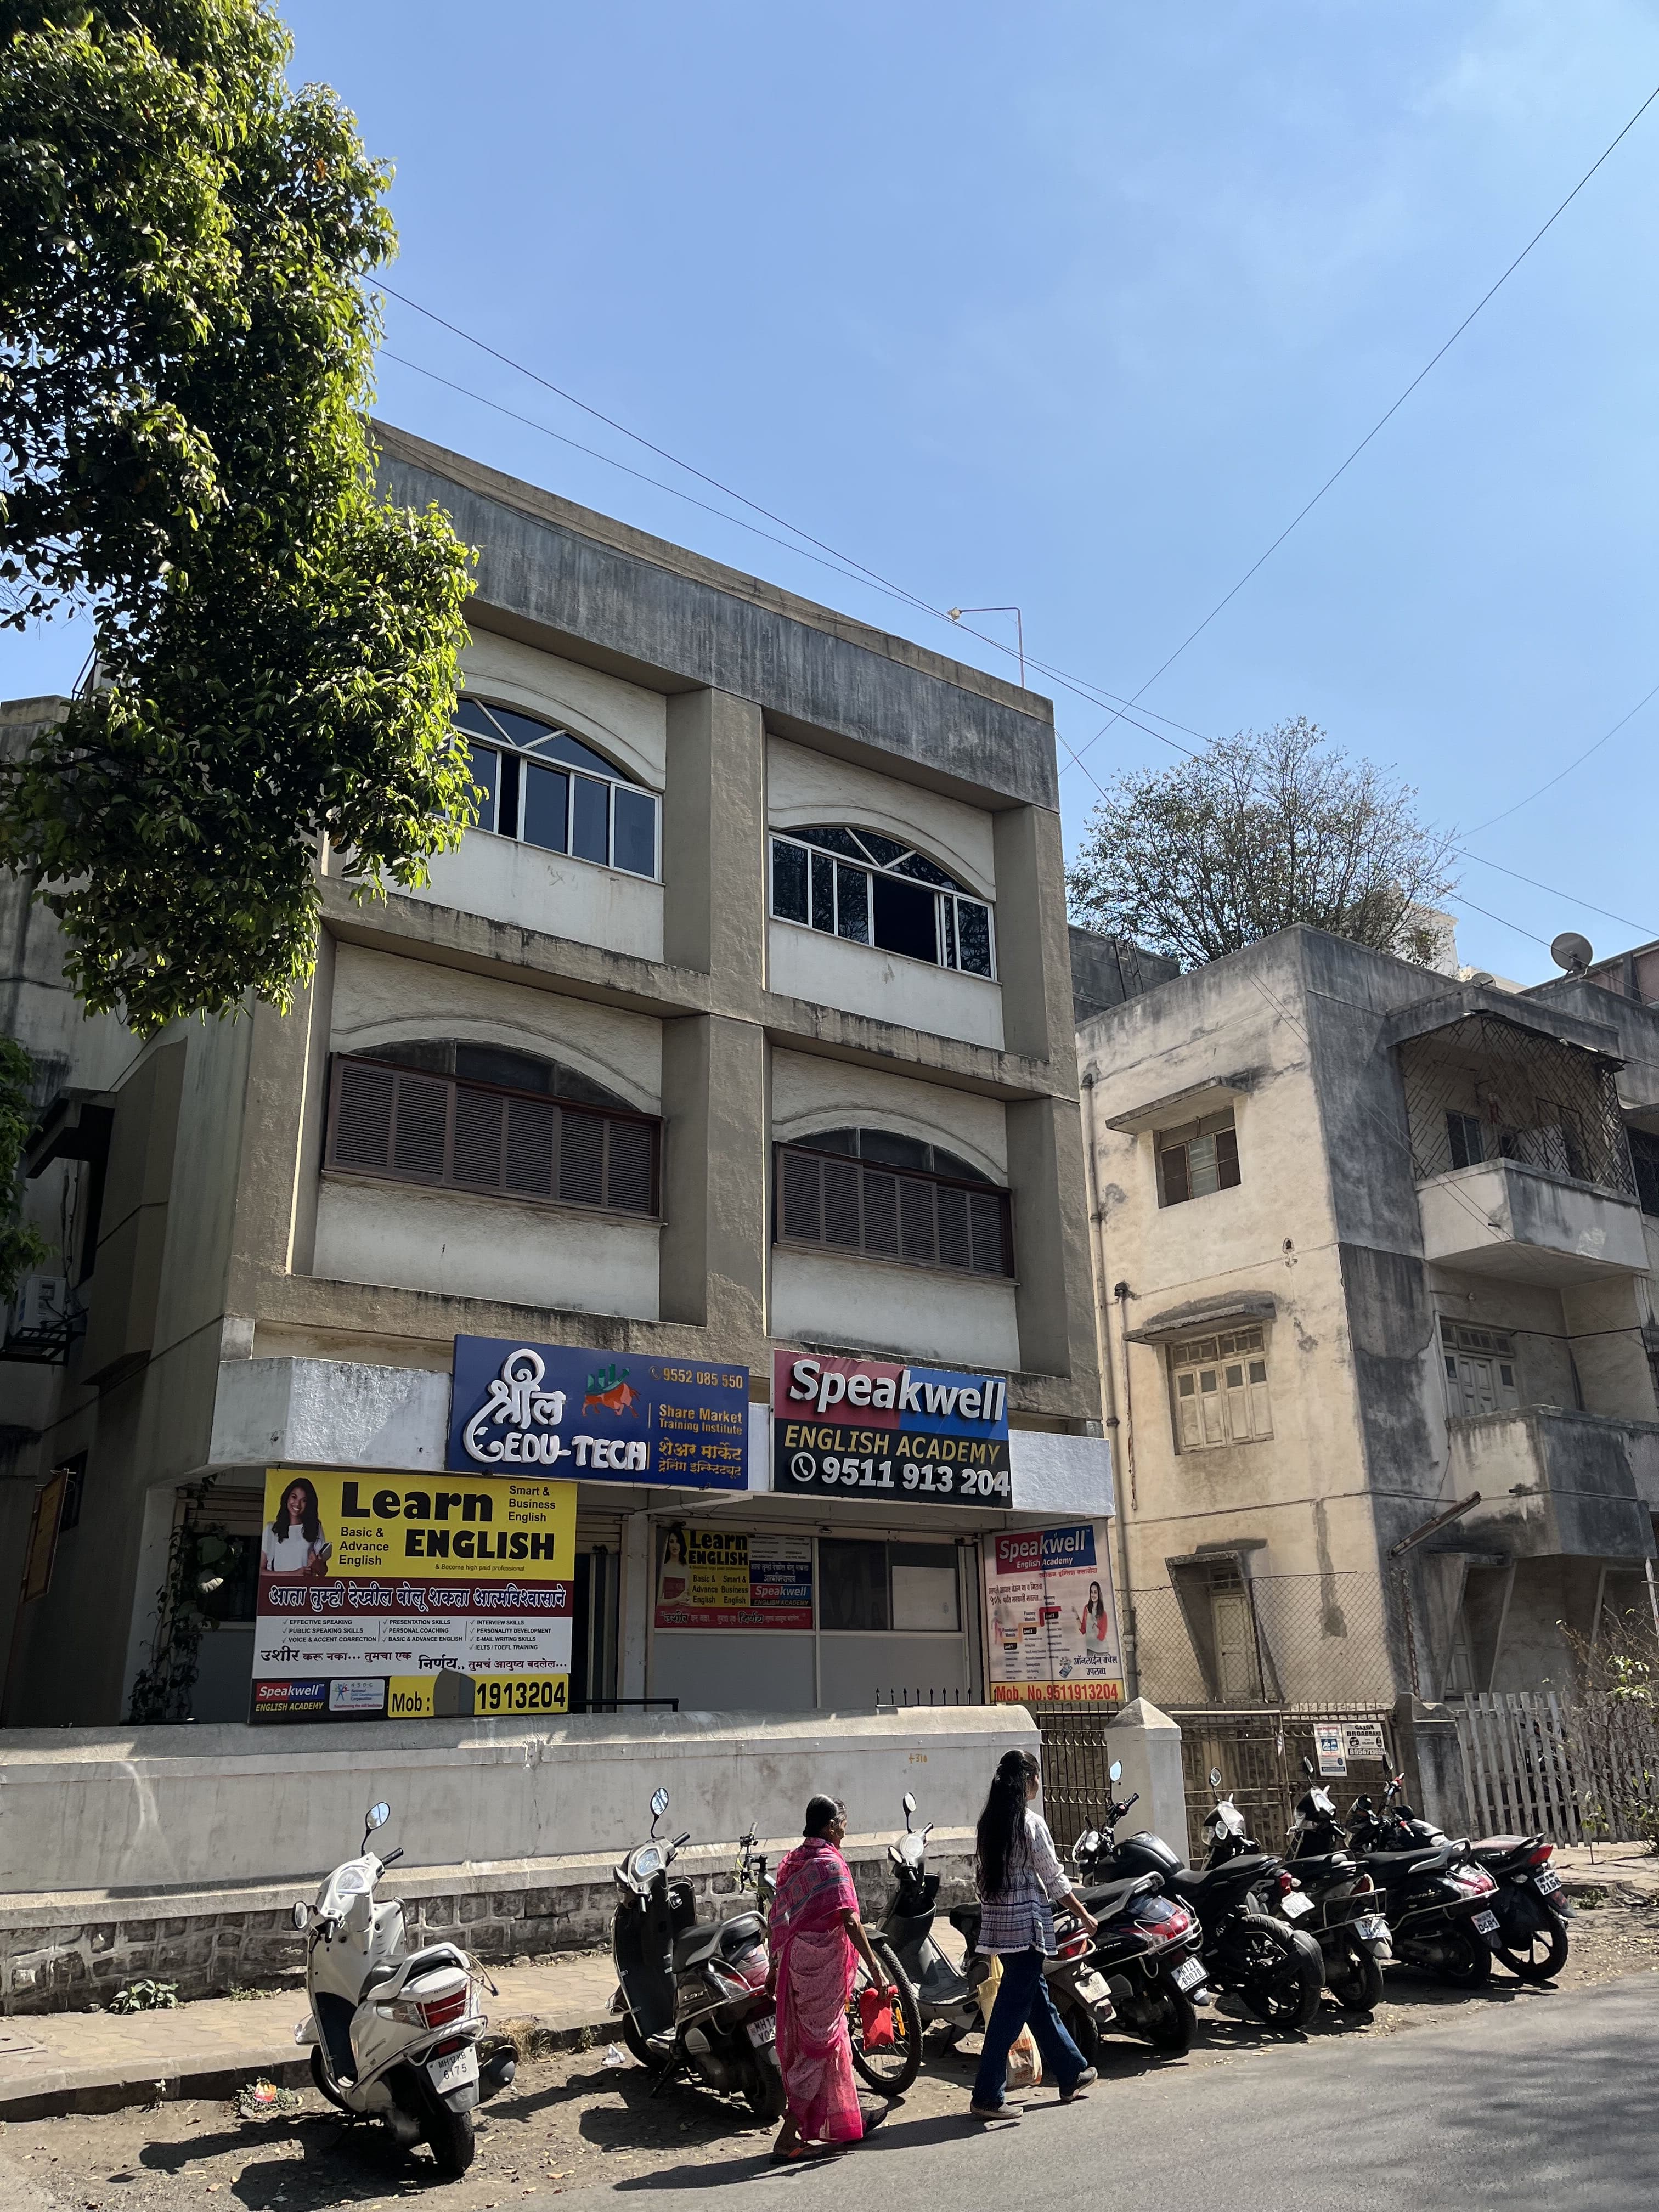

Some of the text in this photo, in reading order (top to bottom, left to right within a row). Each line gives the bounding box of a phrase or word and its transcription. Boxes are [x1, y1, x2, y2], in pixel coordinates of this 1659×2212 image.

[663, 1368, 743, 1389] 9552 085 550
[789, 1359, 1006, 1421] Speakwell
[659, 1404, 742, 1424] Share Market
[659, 1418, 742, 1435] Training Institute
[501, 1432, 647, 1471] EDU-TECH
[659, 1437, 742, 1460] शेअर मार्केट
[785, 1425, 1001, 1465] ENGLISH ACADEMY
[821, 1456, 1011, 1497] 9511 913 204
[510, 1485, 550, 1496] Smart &
[341, 1481, 493, 1522] Learn
[509, 1498, 556, 1509] Business
[509, 1511, 546, 1523] English
[341, 1527, 383, 1537] Basic &
[690, 1530, 748, 1550] Learn
[339, 1541, 389, 1551] Advance
[405, 1528, 555, 1560] ENGLISH
[999, 1530, 1085, 1562] Speakwell
[339, 1555, 382, 1567] English
[689, 1550, 748, 1566] ENGLISH
[1017, 1556, 1073, 1569] English Academy
[693, 1575, 716, 1583] Basic &
[269, 1580, 566, 1612] आता तुम्ही देखील बोलू शकता आत्मविश्वासाने
[721, 1585, 748, 1594] Business
[755, 1586, 807, 1598] Speakwell
[693, 1595, 715, 1605] English
[724, 1596, 746, 1605] English
[261, 1645, 300, 1662] उशीर
[303, 1652, 324, 1661] करू
[364, 1652, 392, 1663] तुमचा
[395, 1652, 412, 1661] एक
[494, 1660, 524, 1671] आयुष्य
[259, 1684, 319, 1699] Speakwell
[392, 1691, 422, 1712] Mob
[477, 1681, 566, 1710] 1913204
[996, 1685, 1023, 1701] Mob.
[256, 1702, 324, 1712] ENGLISH ACADEMY
[1541, 1877, 1561, 1893] 2158
[1478, 1918, 1498, 1932] 0481
[443, 2063, 467, 2079] 6175
